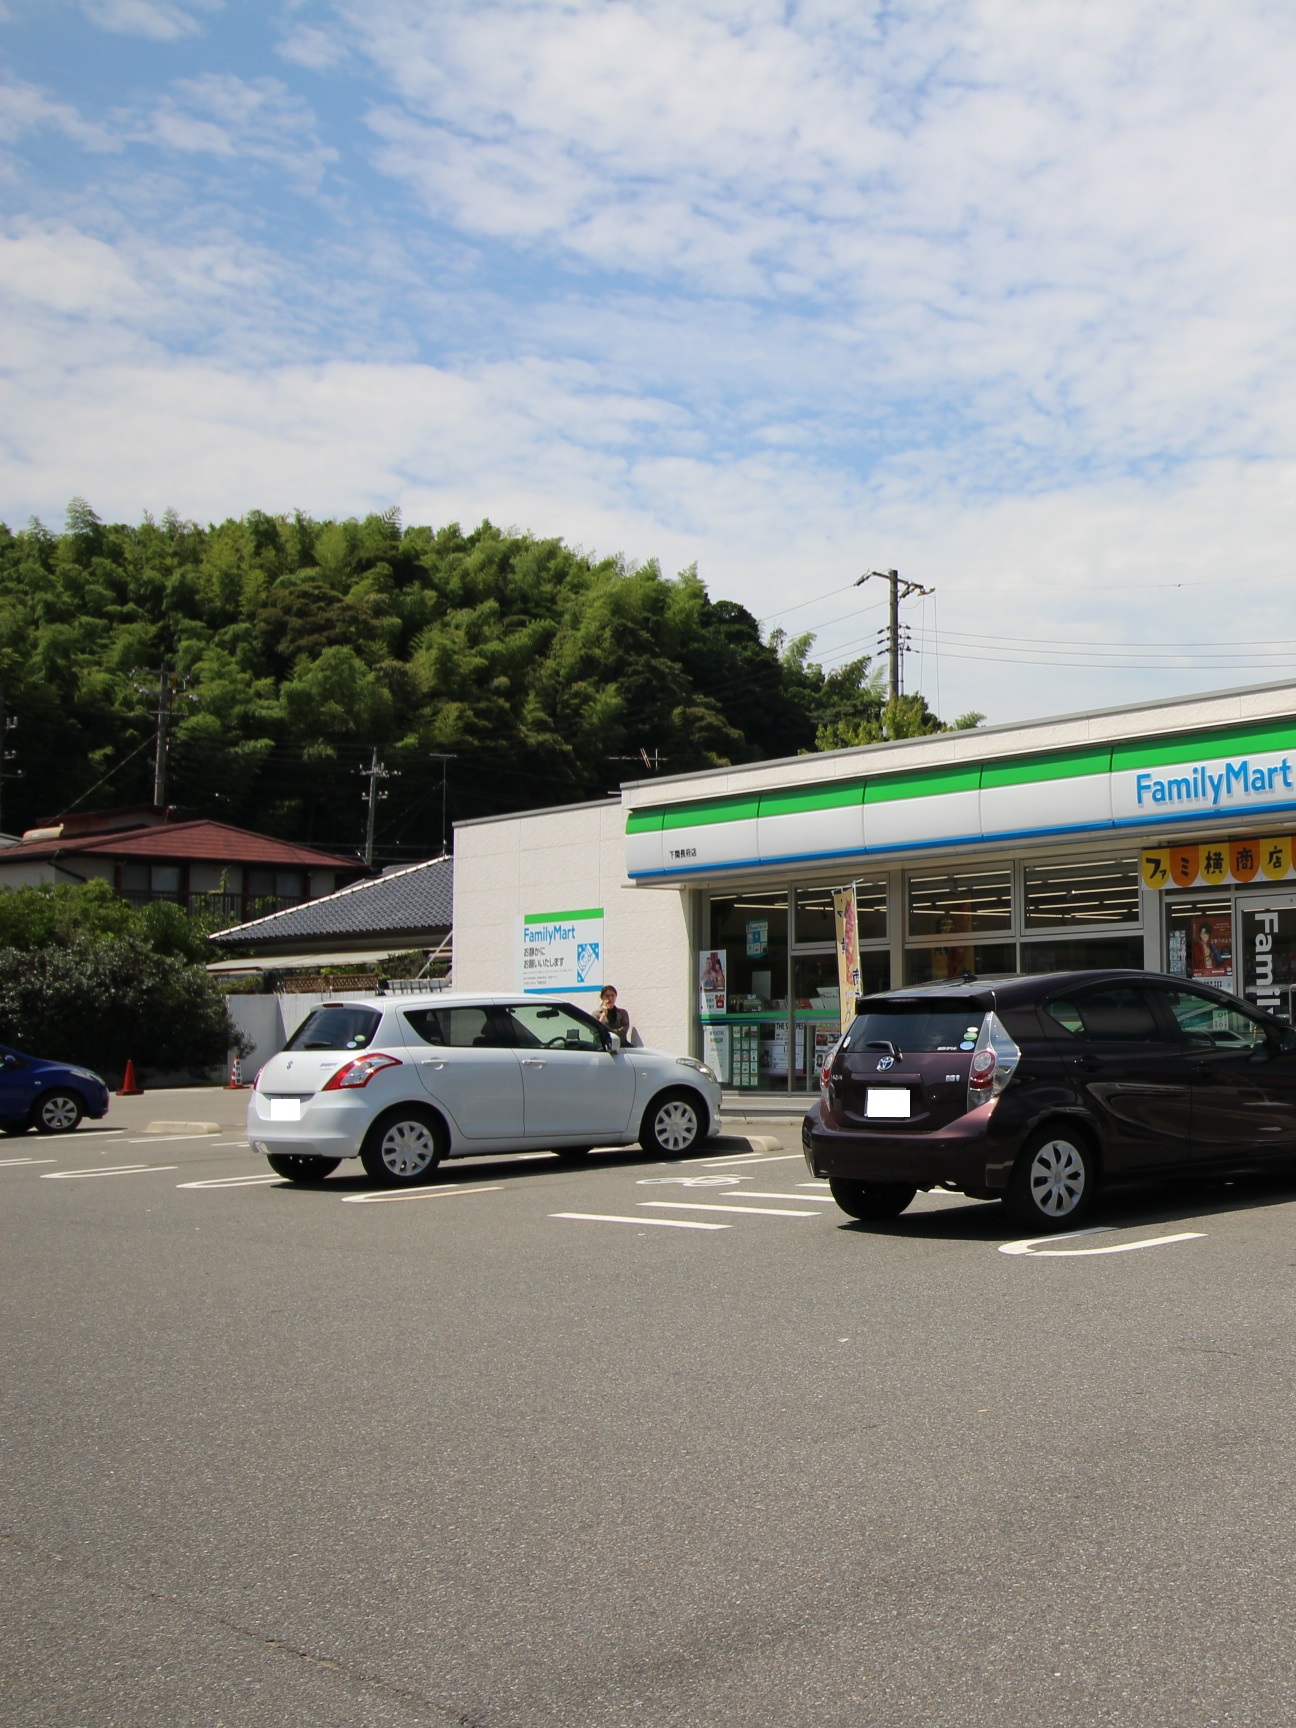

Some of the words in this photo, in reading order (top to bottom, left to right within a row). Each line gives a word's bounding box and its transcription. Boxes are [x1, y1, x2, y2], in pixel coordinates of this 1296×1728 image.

[1136, 757, 1292, 805] FamilyMart
[523, 925, 576, 946] FamilyMart
[1254, 912, 1281, 1015] Famil
